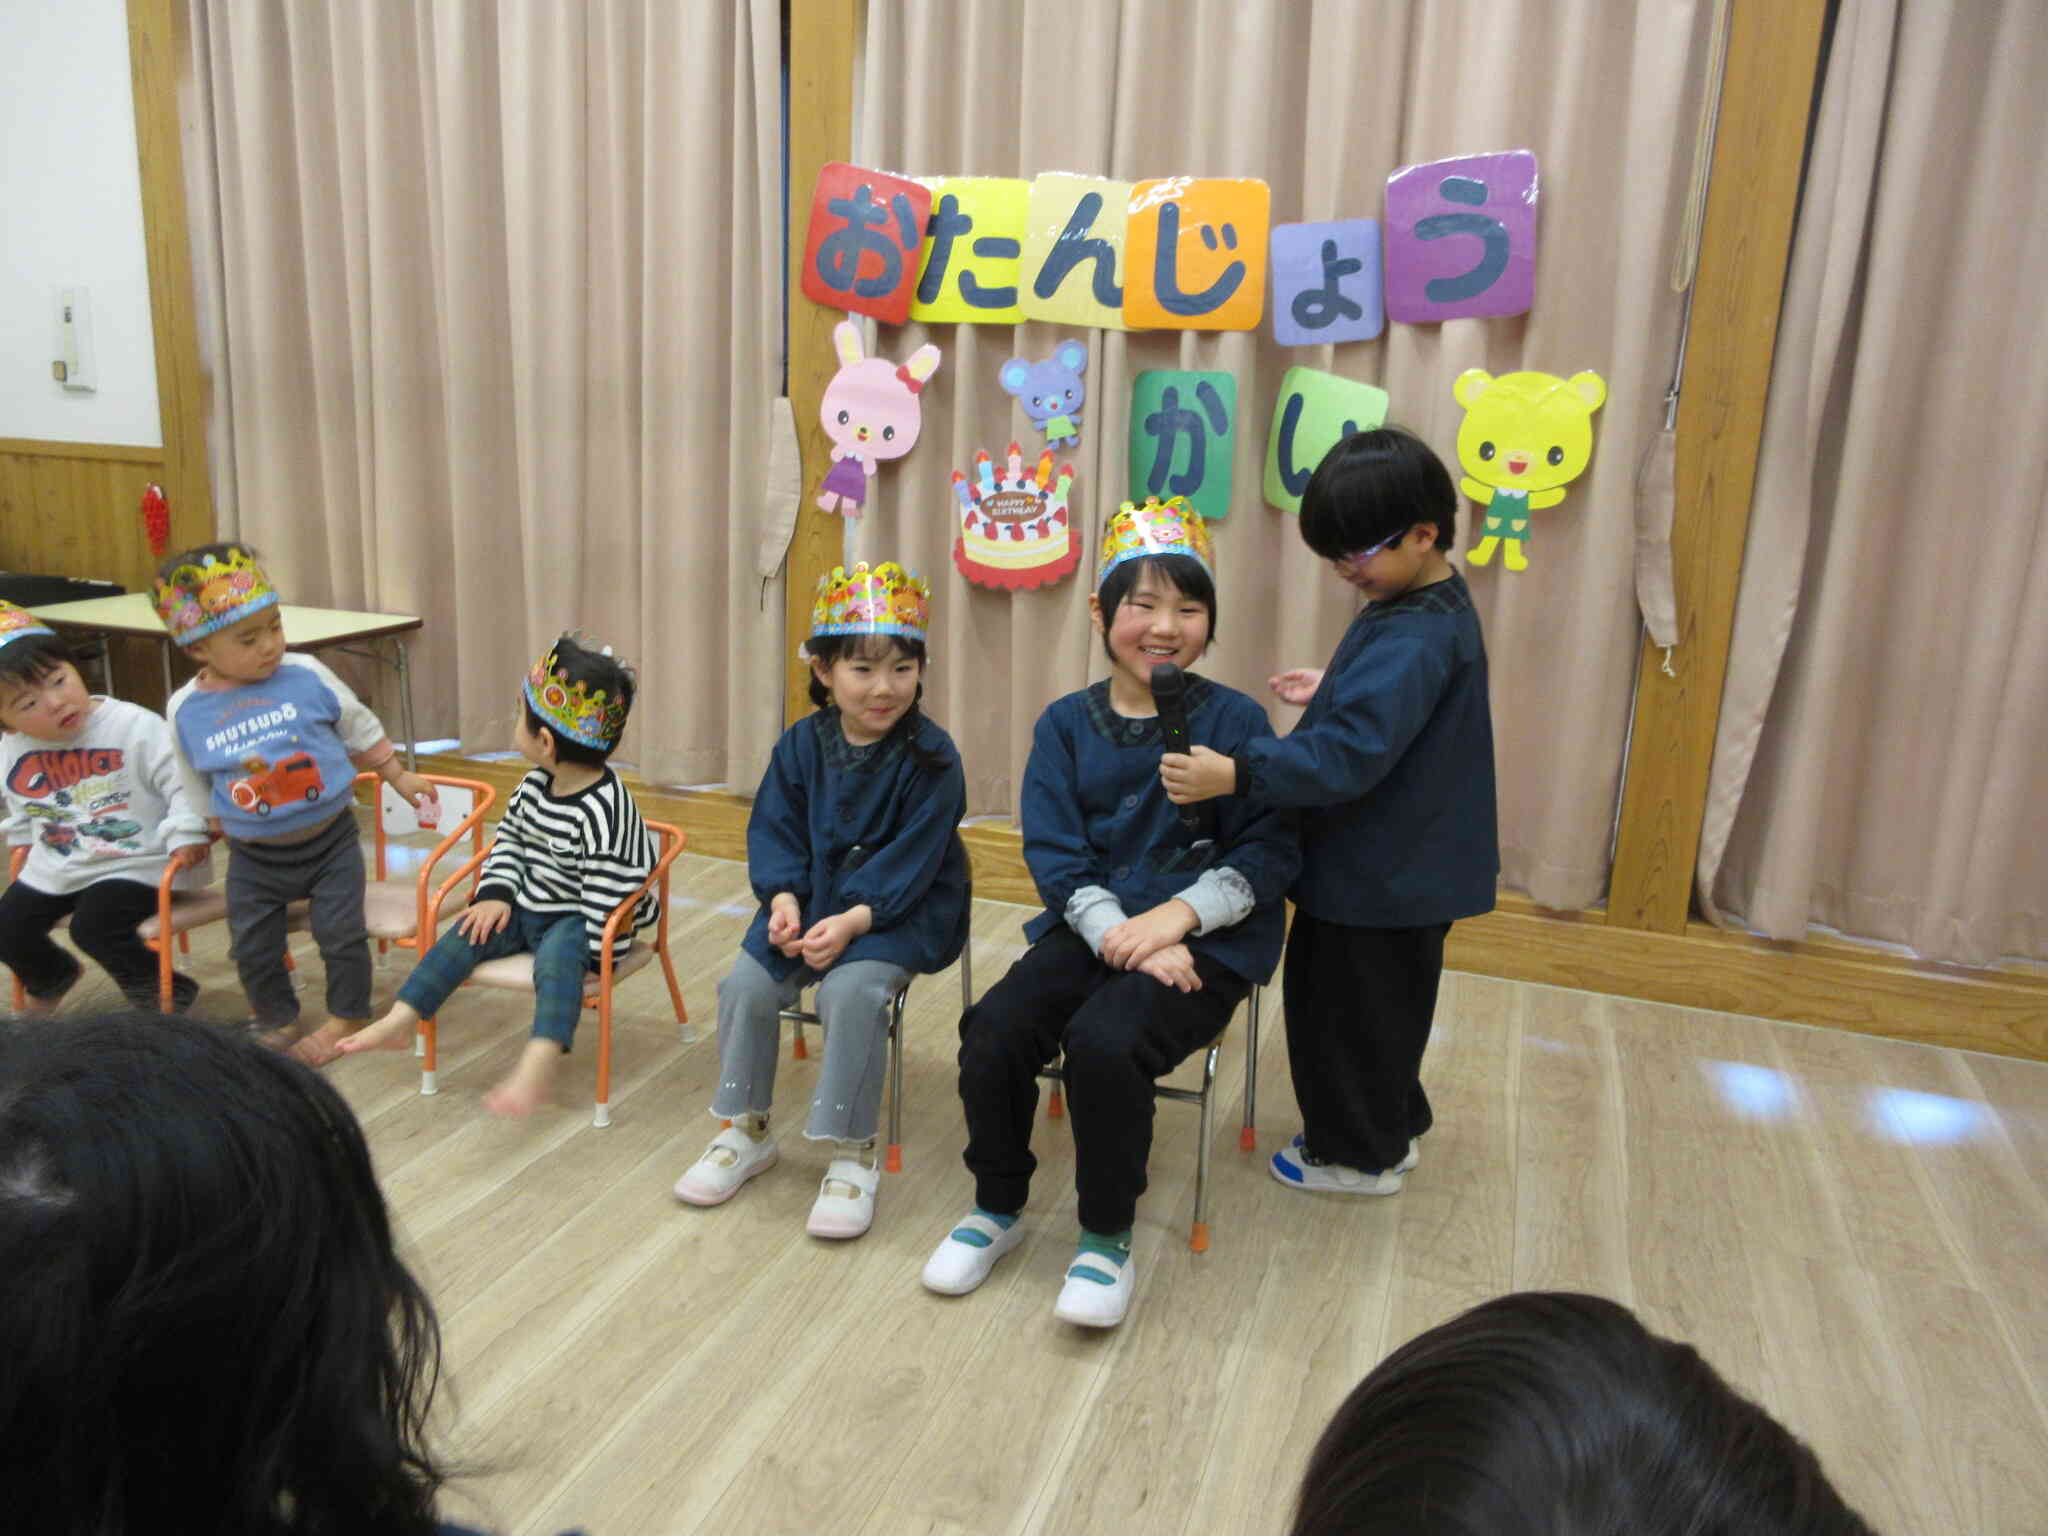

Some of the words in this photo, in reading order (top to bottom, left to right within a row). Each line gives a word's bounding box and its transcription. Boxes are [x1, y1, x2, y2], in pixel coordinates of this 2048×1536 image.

[816, 177, 1511, 331] おたんじょう
[7, 747, 125, 799] CHOICE
